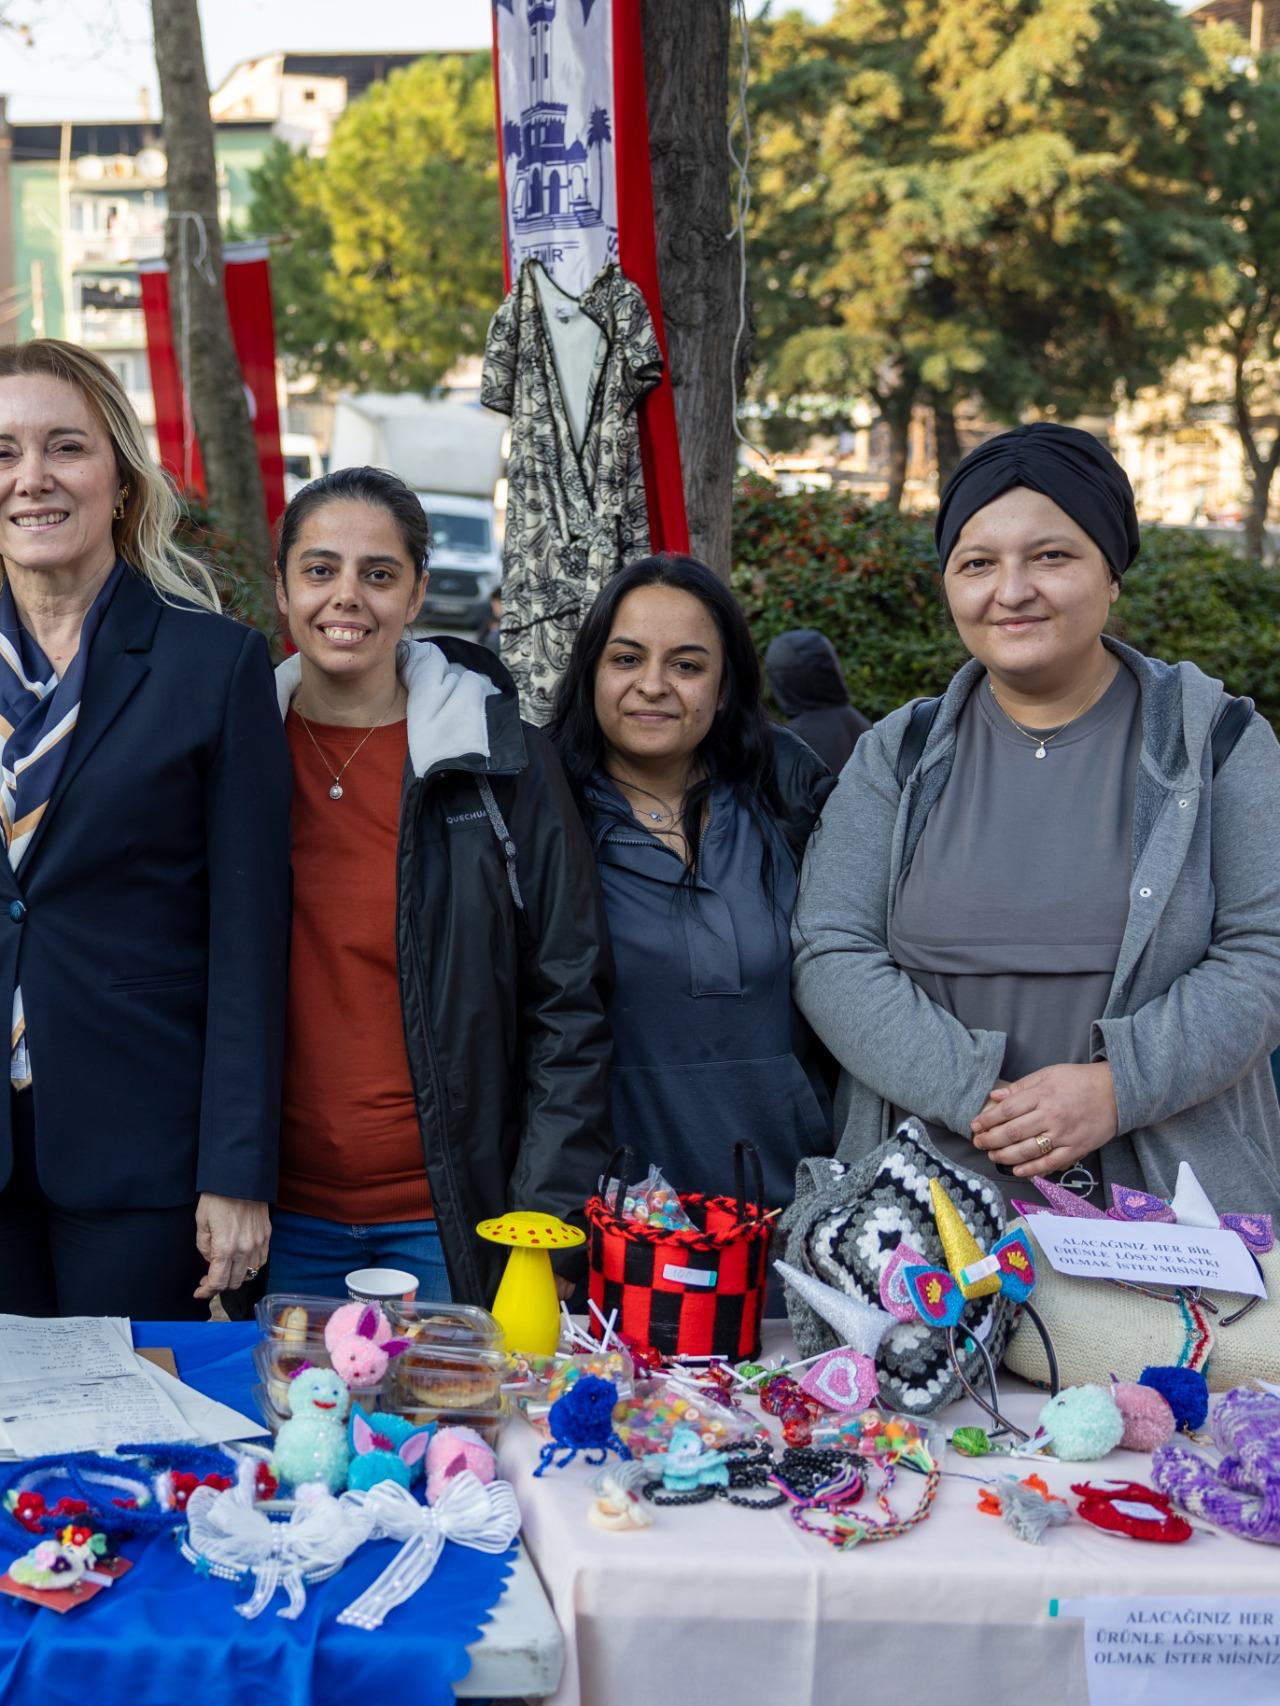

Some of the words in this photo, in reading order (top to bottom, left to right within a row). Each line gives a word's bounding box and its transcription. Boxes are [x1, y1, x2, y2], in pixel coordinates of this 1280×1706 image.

[1061, 1237, 1145, 1250] ALACAĞINIZ
[1152, 1243, 1181, 1255] HER
[1188, 1244, 1212, 1256] BİR
[1053, 1245, 1110, 1259] ÜRÜNLE
[1115, 1251, 1175, 1263] LÖSEV'E
[1176, 1257, 1220, 1267] KATKI
[1058, 1256, 1111, 1268] OLMAK
[1116, 1260, 1157, 1272] İSTER
[1160, 1264, 1219, 1278] MİSİNİZ?
[1126, 1608, 1231, 1625] ALACAĞINIZ
[1239, 1612, 1274, 1625] HER
[1096, 1629, 1165, 1645] ÜRÜNLE
[1173, 1630, 1243, 1646] LÖSEV'E
[1094, 1651, 1156, 1665] OLMAK
[1164, 1649, 1212, 1665] İSTER
